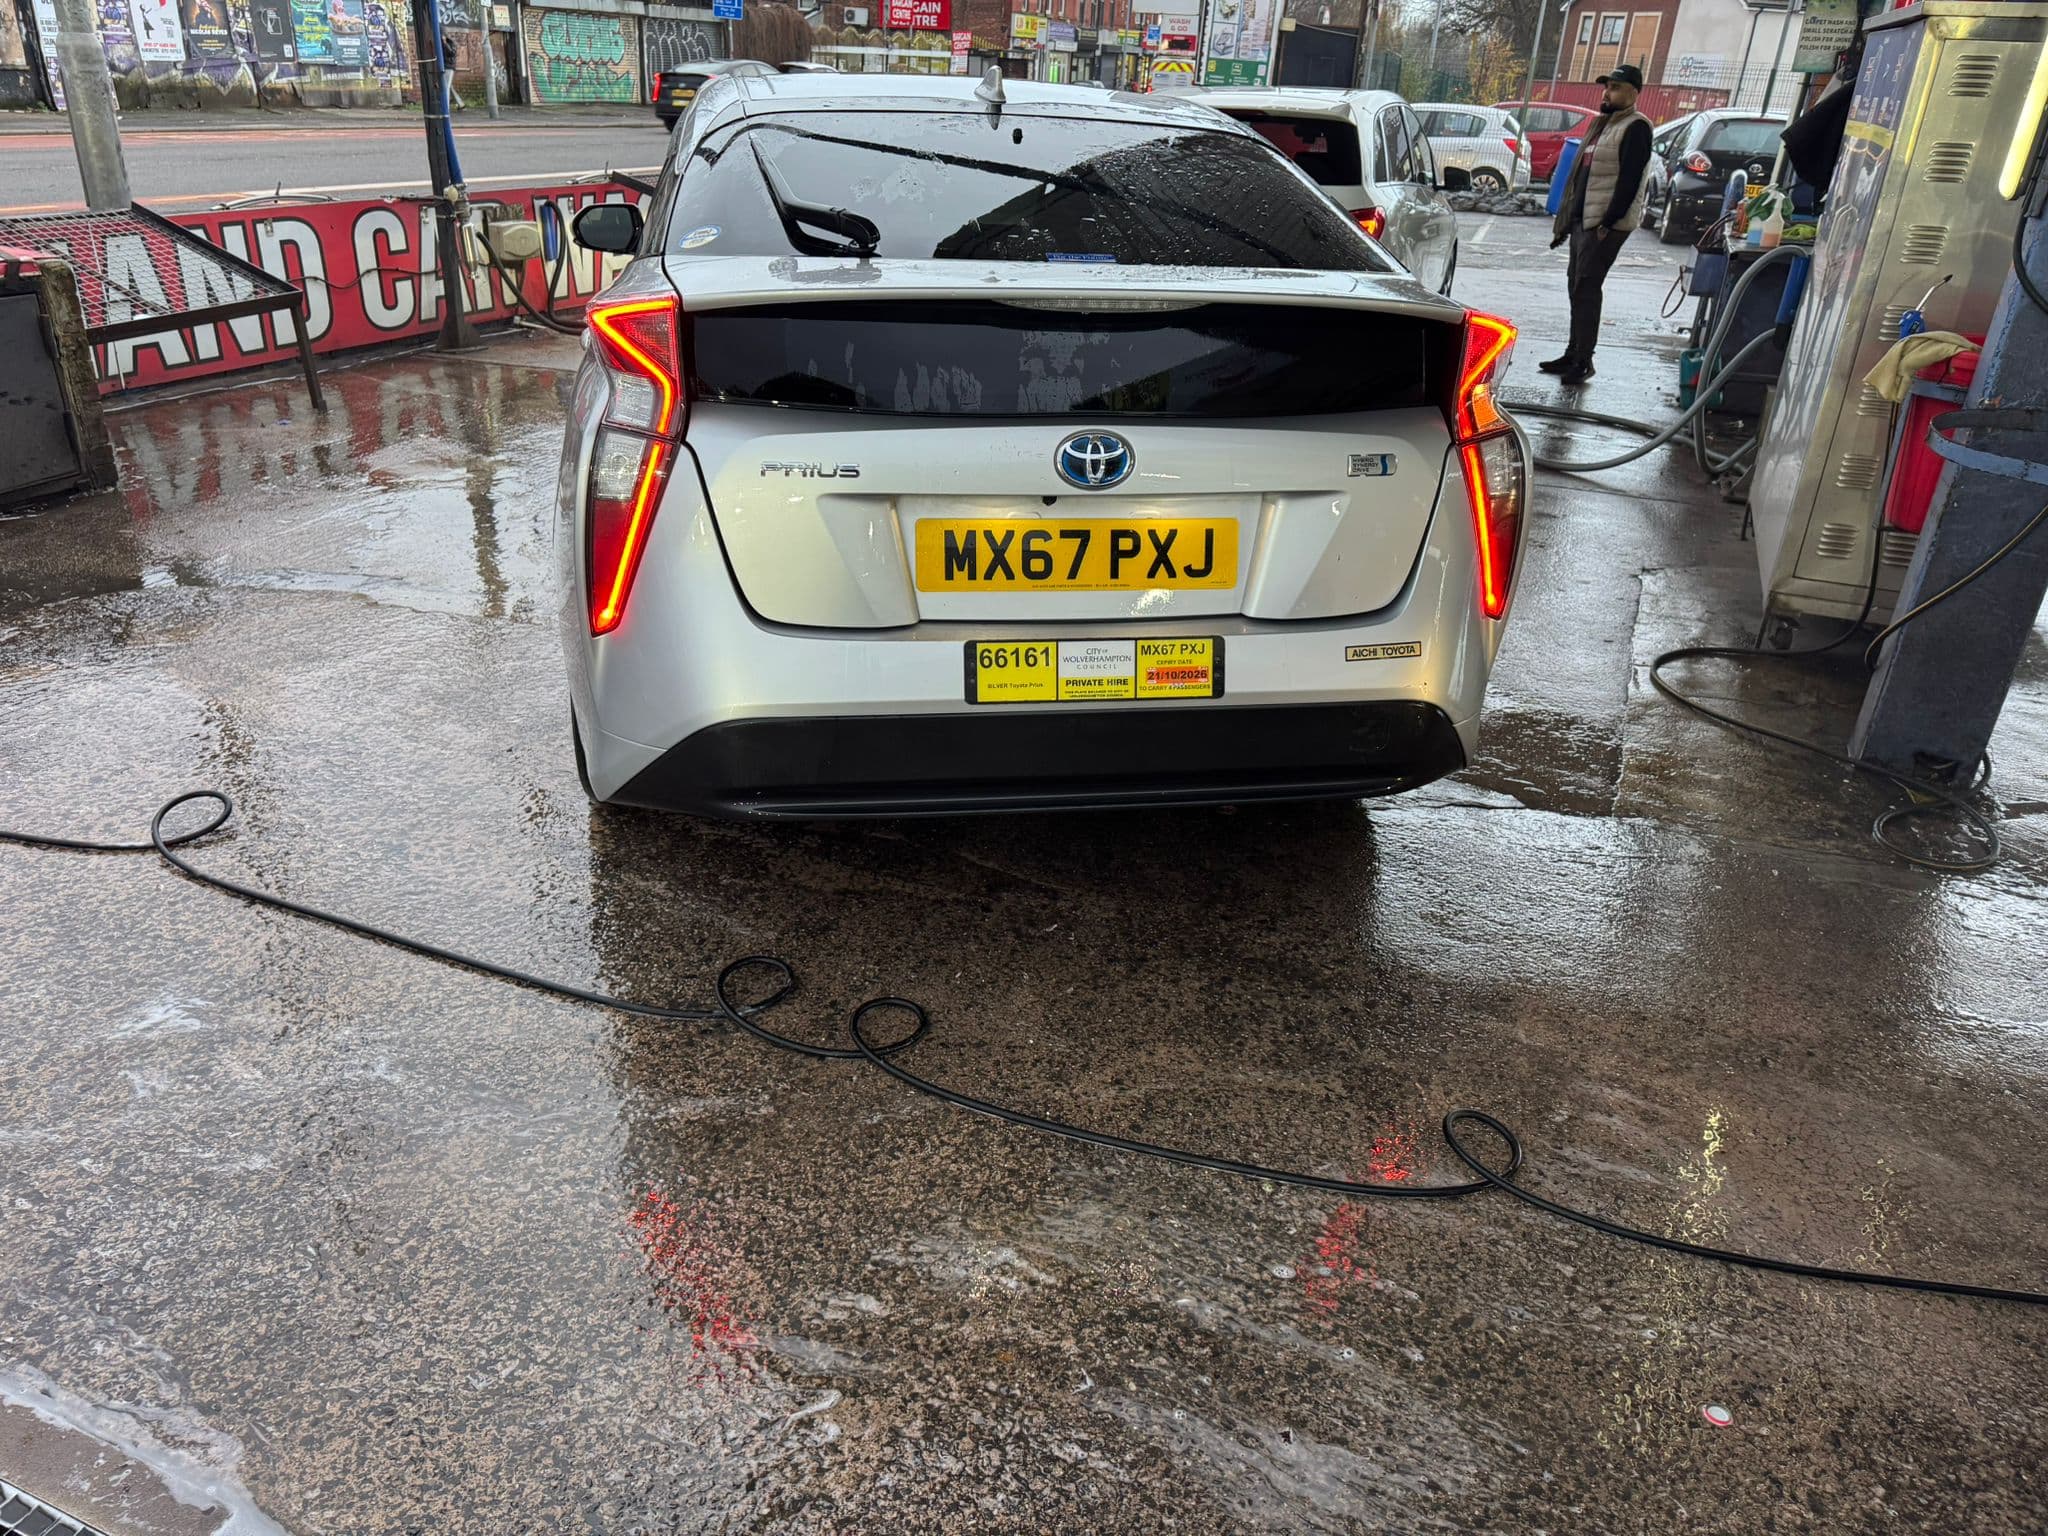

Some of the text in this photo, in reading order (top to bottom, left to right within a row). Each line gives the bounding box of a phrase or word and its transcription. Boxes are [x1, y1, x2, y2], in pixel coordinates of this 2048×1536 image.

[761, 462, 860, 478] PRIUS
[945, 528, 1214, 580] MX67 PXJ
[1141, 643, 1205, 656] MX67 PXJ
[1352, 645, 1415, 658] AICHI TOYOTA
[980, 646, 1050, 669] 66161
[1062, 655, 1132, 663] WOLVERHAMPTON
[1147, 670, 1207, 680] 21/10/2026
[1009, 682, 1028, 690] Toyota
[1065, 678, 1129, 687] PRIVATE HIRE
